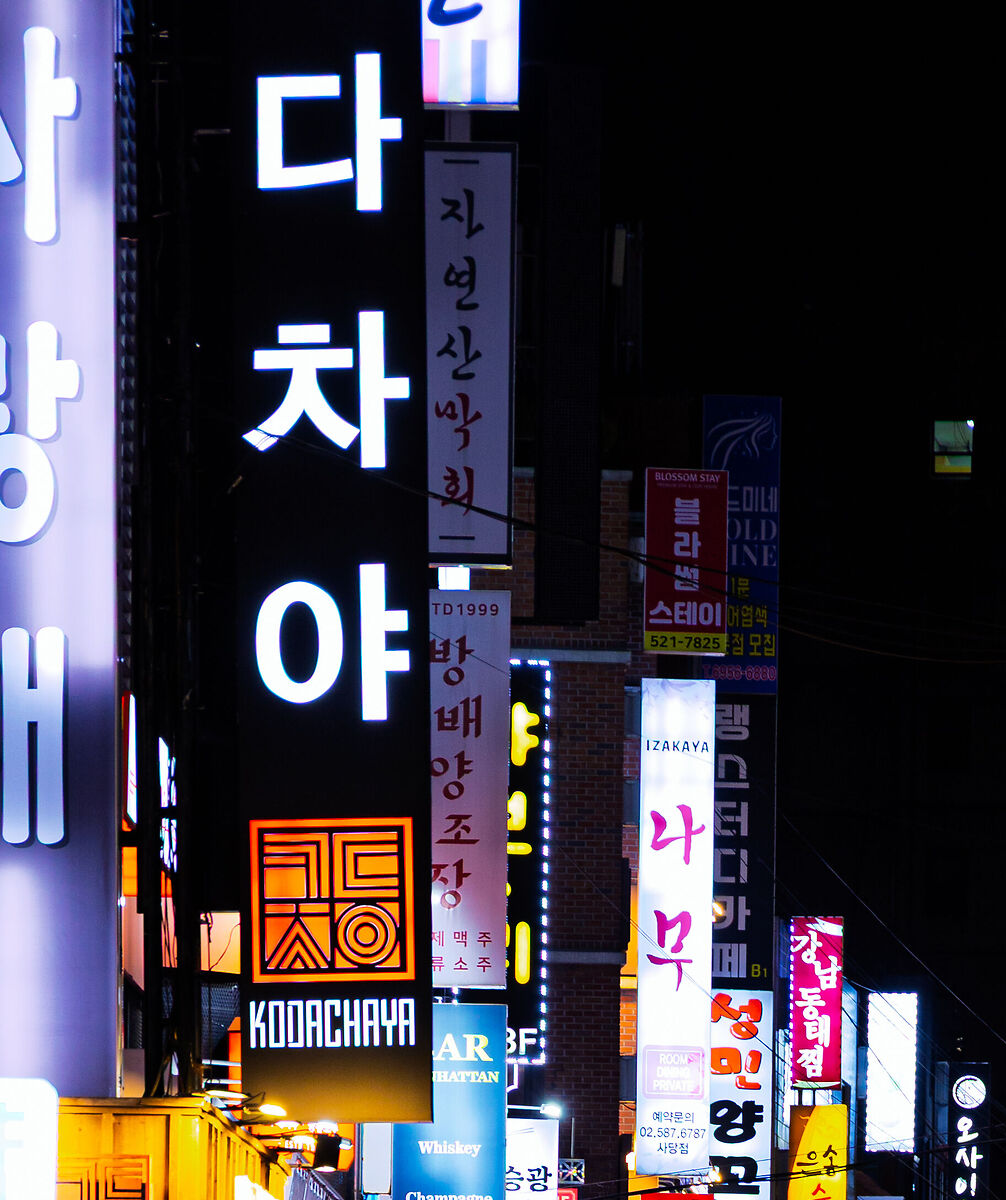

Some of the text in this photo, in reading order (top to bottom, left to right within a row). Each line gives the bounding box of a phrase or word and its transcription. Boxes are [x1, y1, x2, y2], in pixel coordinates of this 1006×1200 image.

[242, 53, 410, 720] 다차야
[655, 472, 721, 483] BLOSSOM STAY
[432, 603, 499, 616] TD1999
[649, 600, 721, 626] 스테이
[650, 634, 720, 649] 521-7825
[646, 740, 709, 753] IZAKAYA
[646, 804, 705, 992] 나무
[249, 998, 416, 1048] KODACHAYA
[432, 1033, 493, 1062] AR
[652, 1111, 694, 1124] 예약문의
[418, 1141, 481, 1157] Whiskey
[657, 1142, 688, 1156] 사당점
